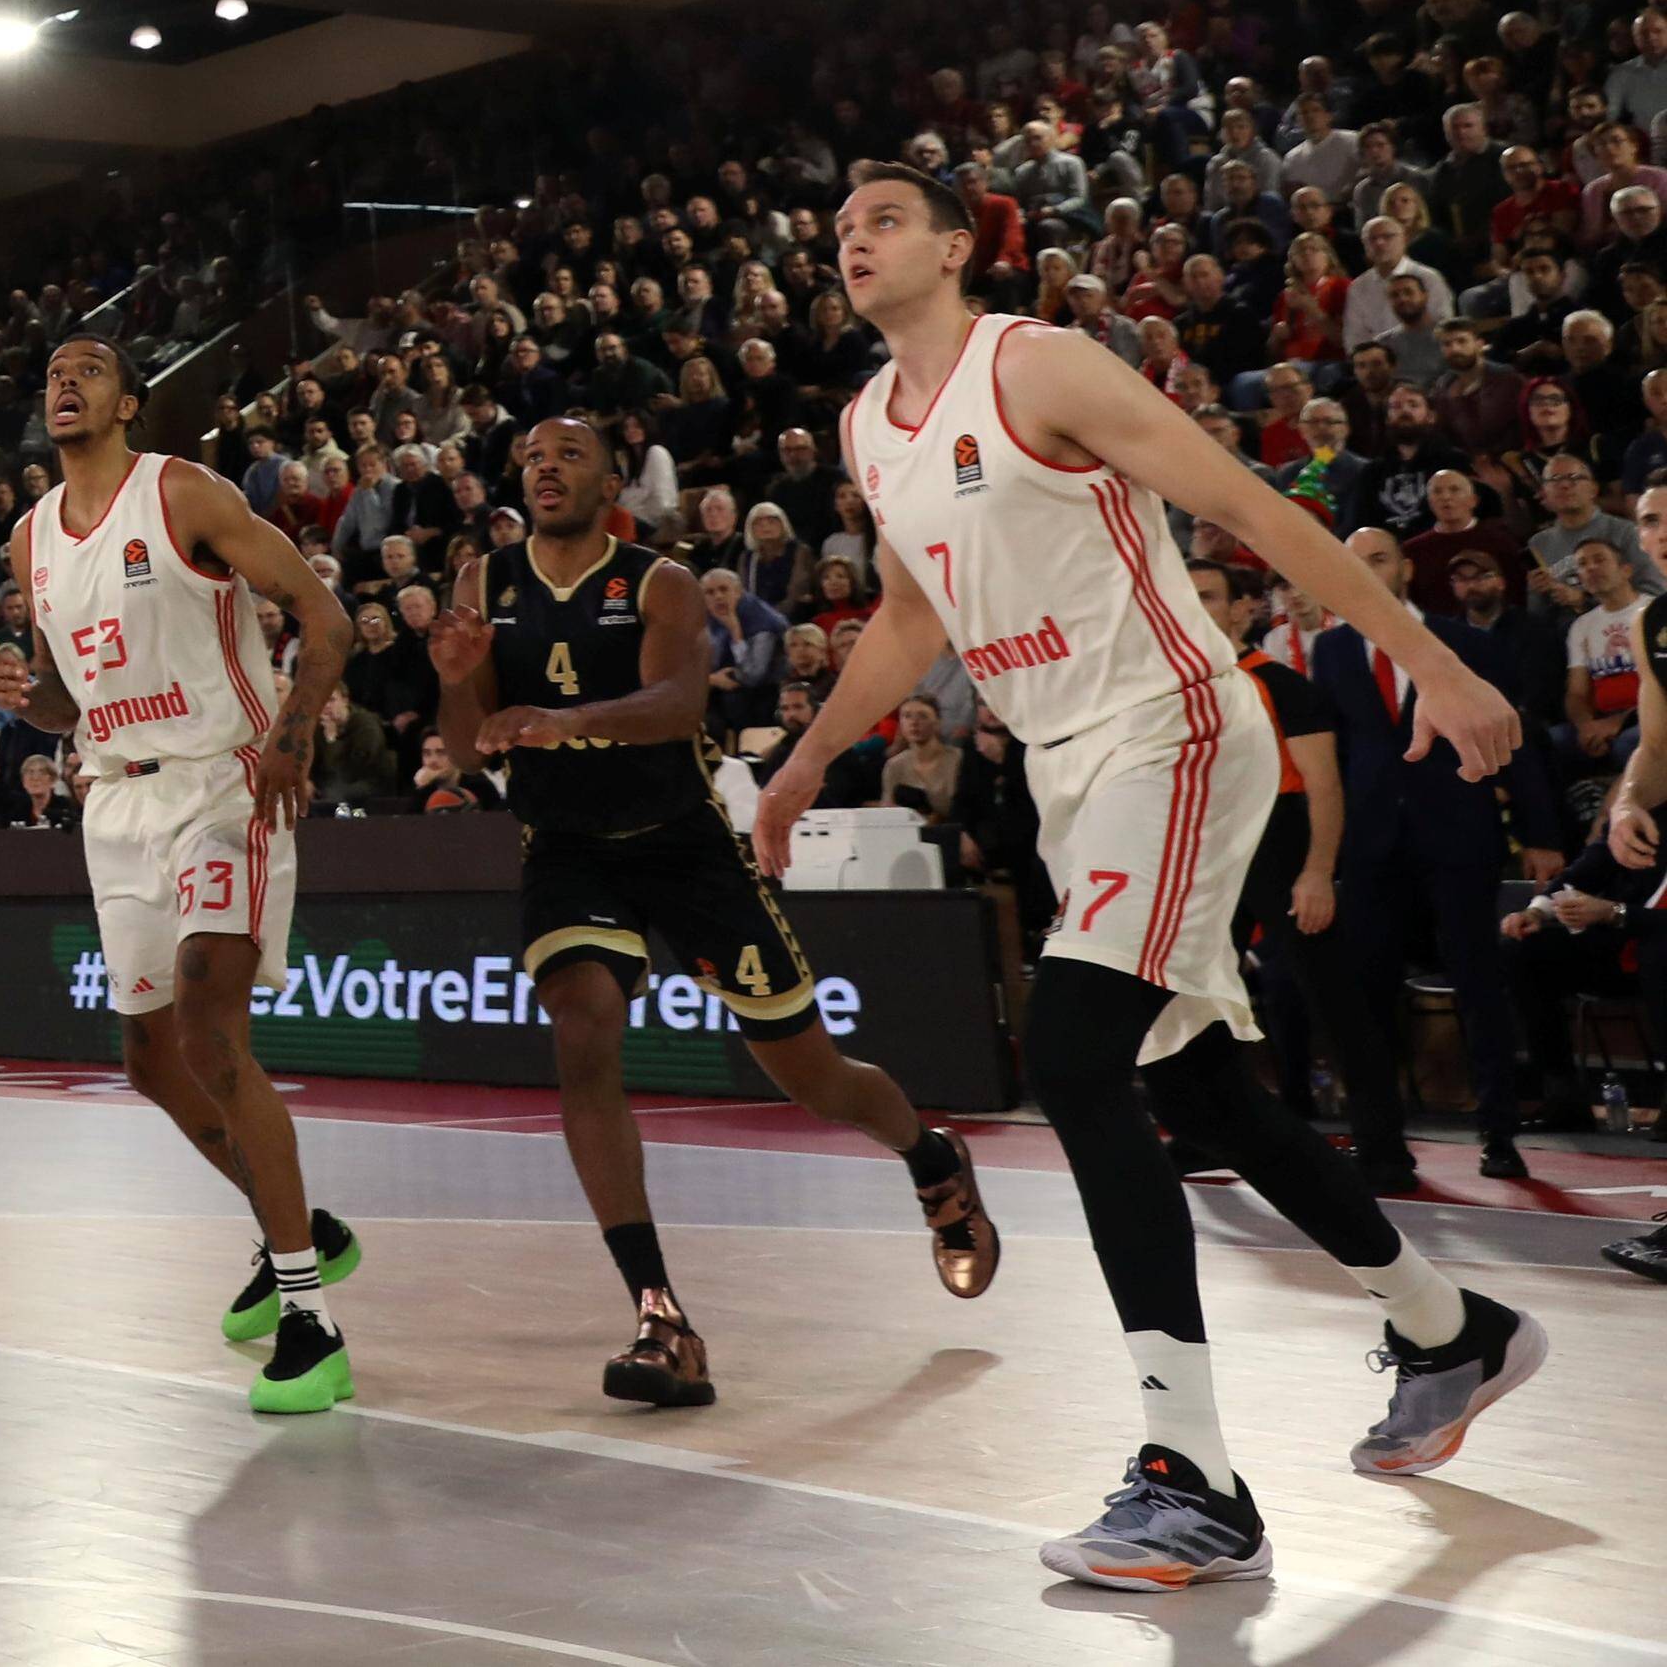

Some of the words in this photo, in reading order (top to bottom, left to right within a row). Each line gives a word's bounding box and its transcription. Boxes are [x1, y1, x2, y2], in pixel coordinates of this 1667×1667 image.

[925, 542, 957, 609] 7
[71, 618, 127, 682] 53
[545, 642, 581, 696] 4
[177, 860, 234, 917] 53
[1079, 870, 1130, 933] 7
[734, 944, 773, 997] 4
